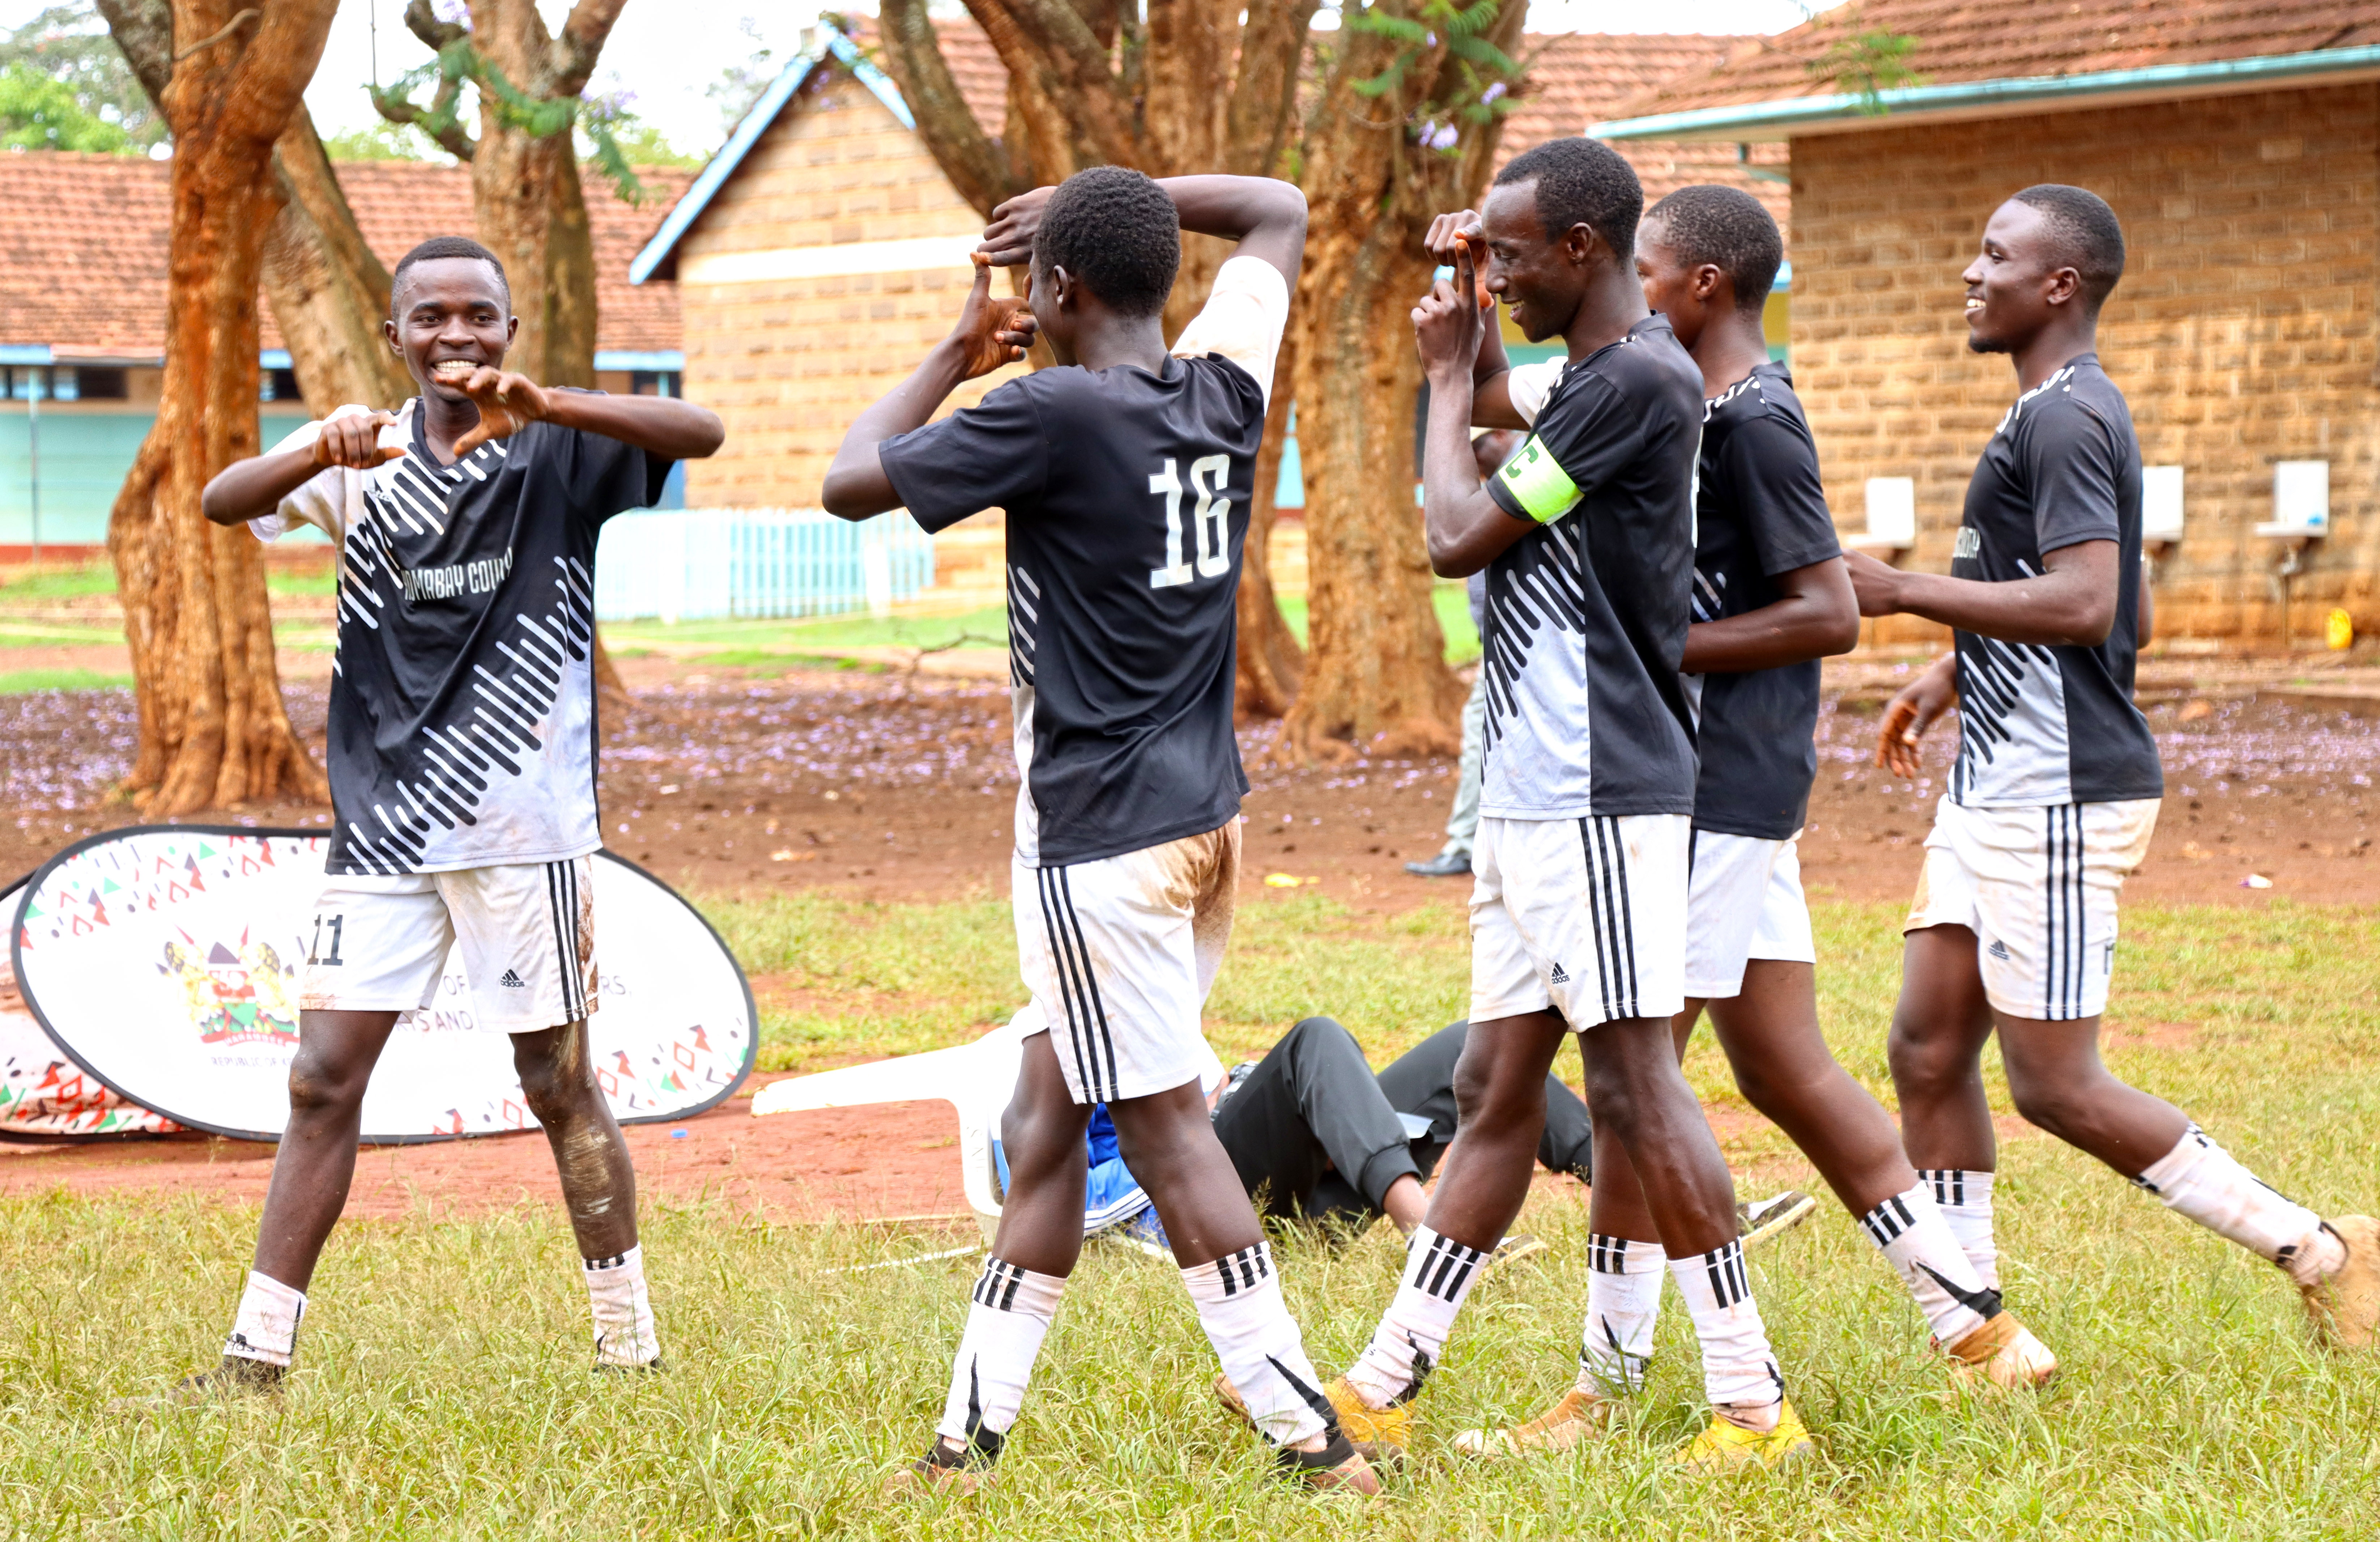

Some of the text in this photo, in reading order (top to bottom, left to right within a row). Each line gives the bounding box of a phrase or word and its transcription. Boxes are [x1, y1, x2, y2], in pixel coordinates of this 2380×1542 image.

[1506, 445, 1538, 478] C
[1148, 453, 1232, 590] 16
[400, 564, 464, 601] HOMABAY
[307, 914, 343, 966] 11
[443, 975, 465, 995] OF
[501, 979, 525, 987] adidas
[1551, 974, 1570, 984] adidas
[434, 1010, 473, 1031] AND
[224, 1033, 284, 1045] HARAMBEE
[211, 1057, 263, 1067] REPUBLIC
[265, 1057, 277, 1067] OF
